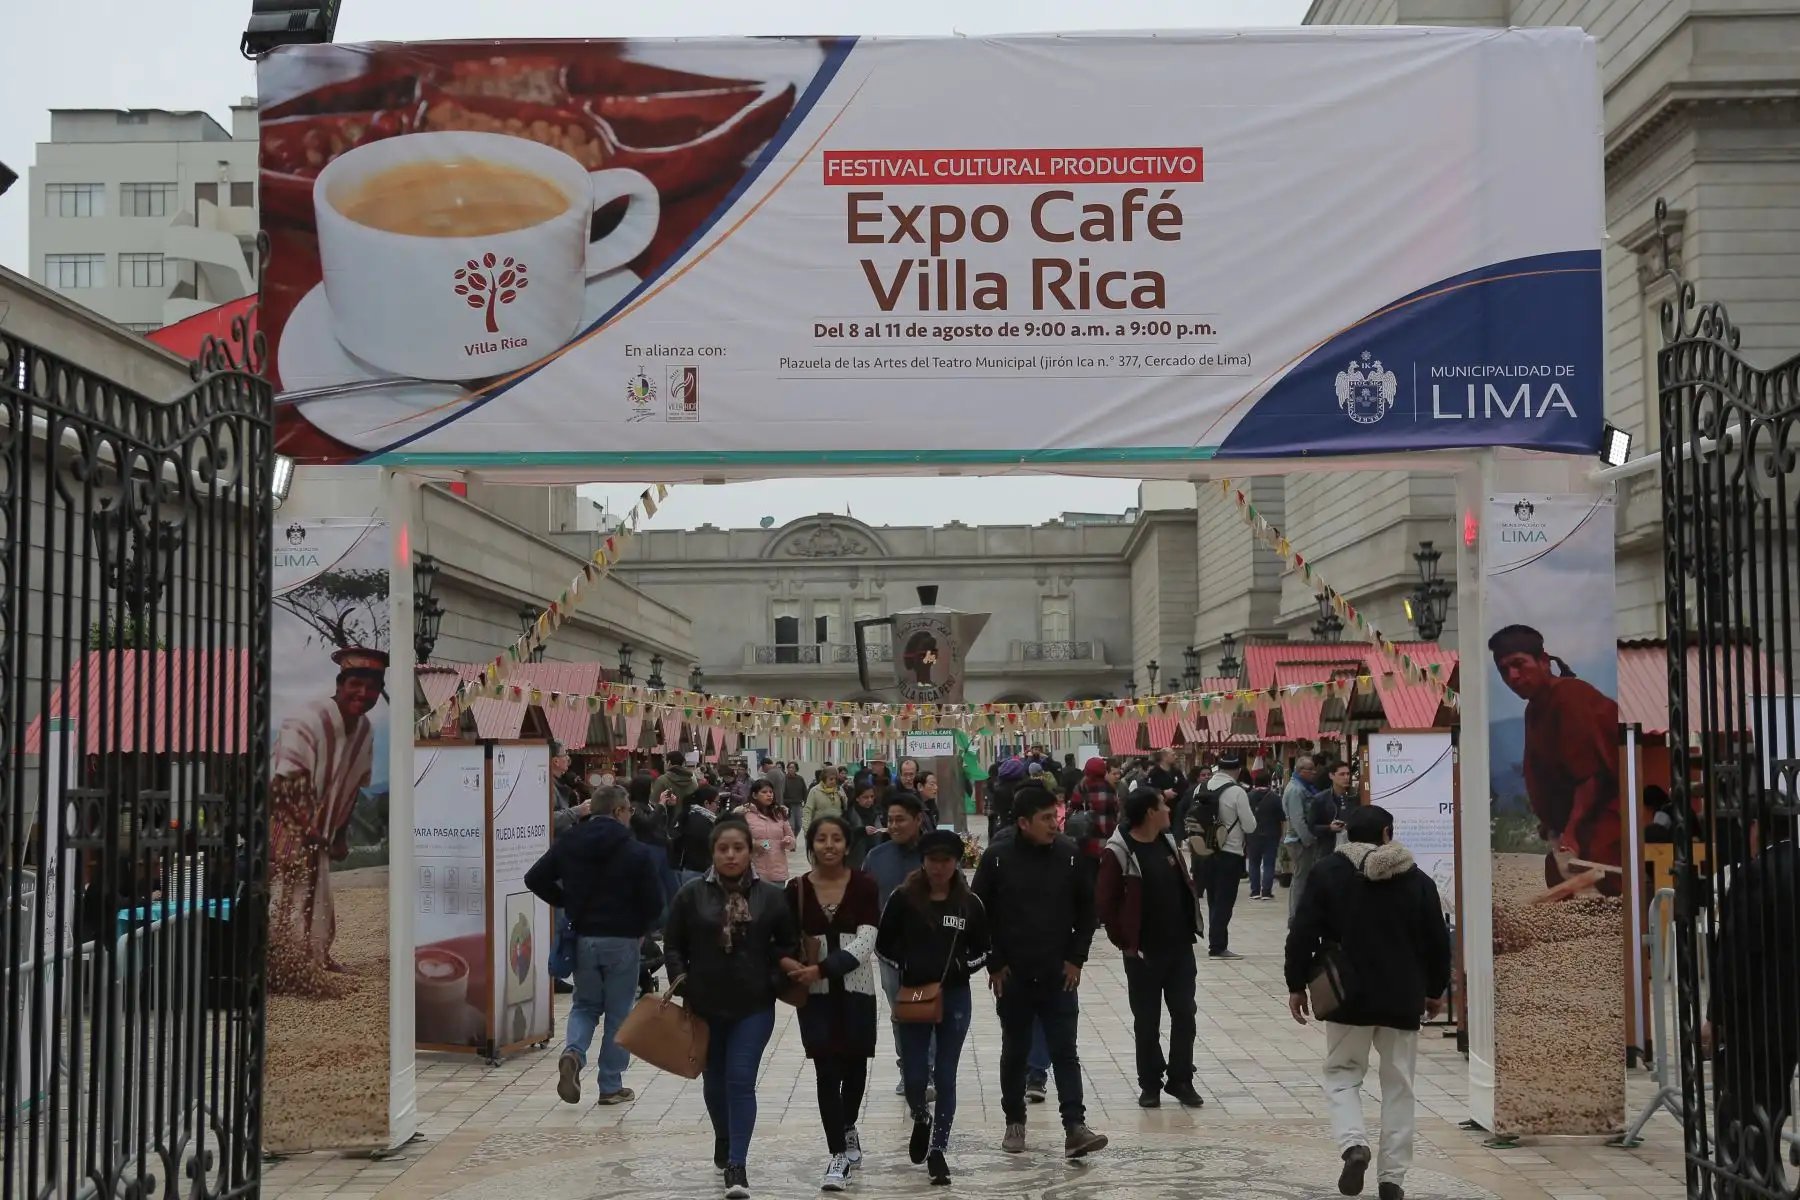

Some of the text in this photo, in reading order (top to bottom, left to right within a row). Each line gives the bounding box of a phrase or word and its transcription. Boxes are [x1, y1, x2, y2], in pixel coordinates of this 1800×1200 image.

[828, 155, 1196, 177] FESTIVAL CULTURAL PRODUCTIVO
[847, 187, 1184, 257] Expo Café
[860, 257, 1166, 312] Villa Rica
[814, 320, 1217, 342] Del 8 al 11 de agosto de 9:00 a.m. a 9:00 p.m.
[464, 337, 528, 356] Villa Rica
[625, 344, 726, 357] En alianza con:
[780, 352, 1252, 371] Plazuela de las Artes del Teatro Municipal (jirón Ica n.° 377, Cercado de Lima)
[1431, 365, 1575, 378] MUNICIPALIDAD DE
[1432, 382, 1578, 419] LIMA
[1502, 530, 1548, 543] LIMA
[274, 554, 320, 567] LIMA
[918, 691, 940, 704] RICA
[937, 742, 951, 750] RICA
[1376, 764, 1415, 775] LIMA
[433, 827, 459, 838] PASAR
[496, 824, 546, 841] RUEDA DEL SABOR
